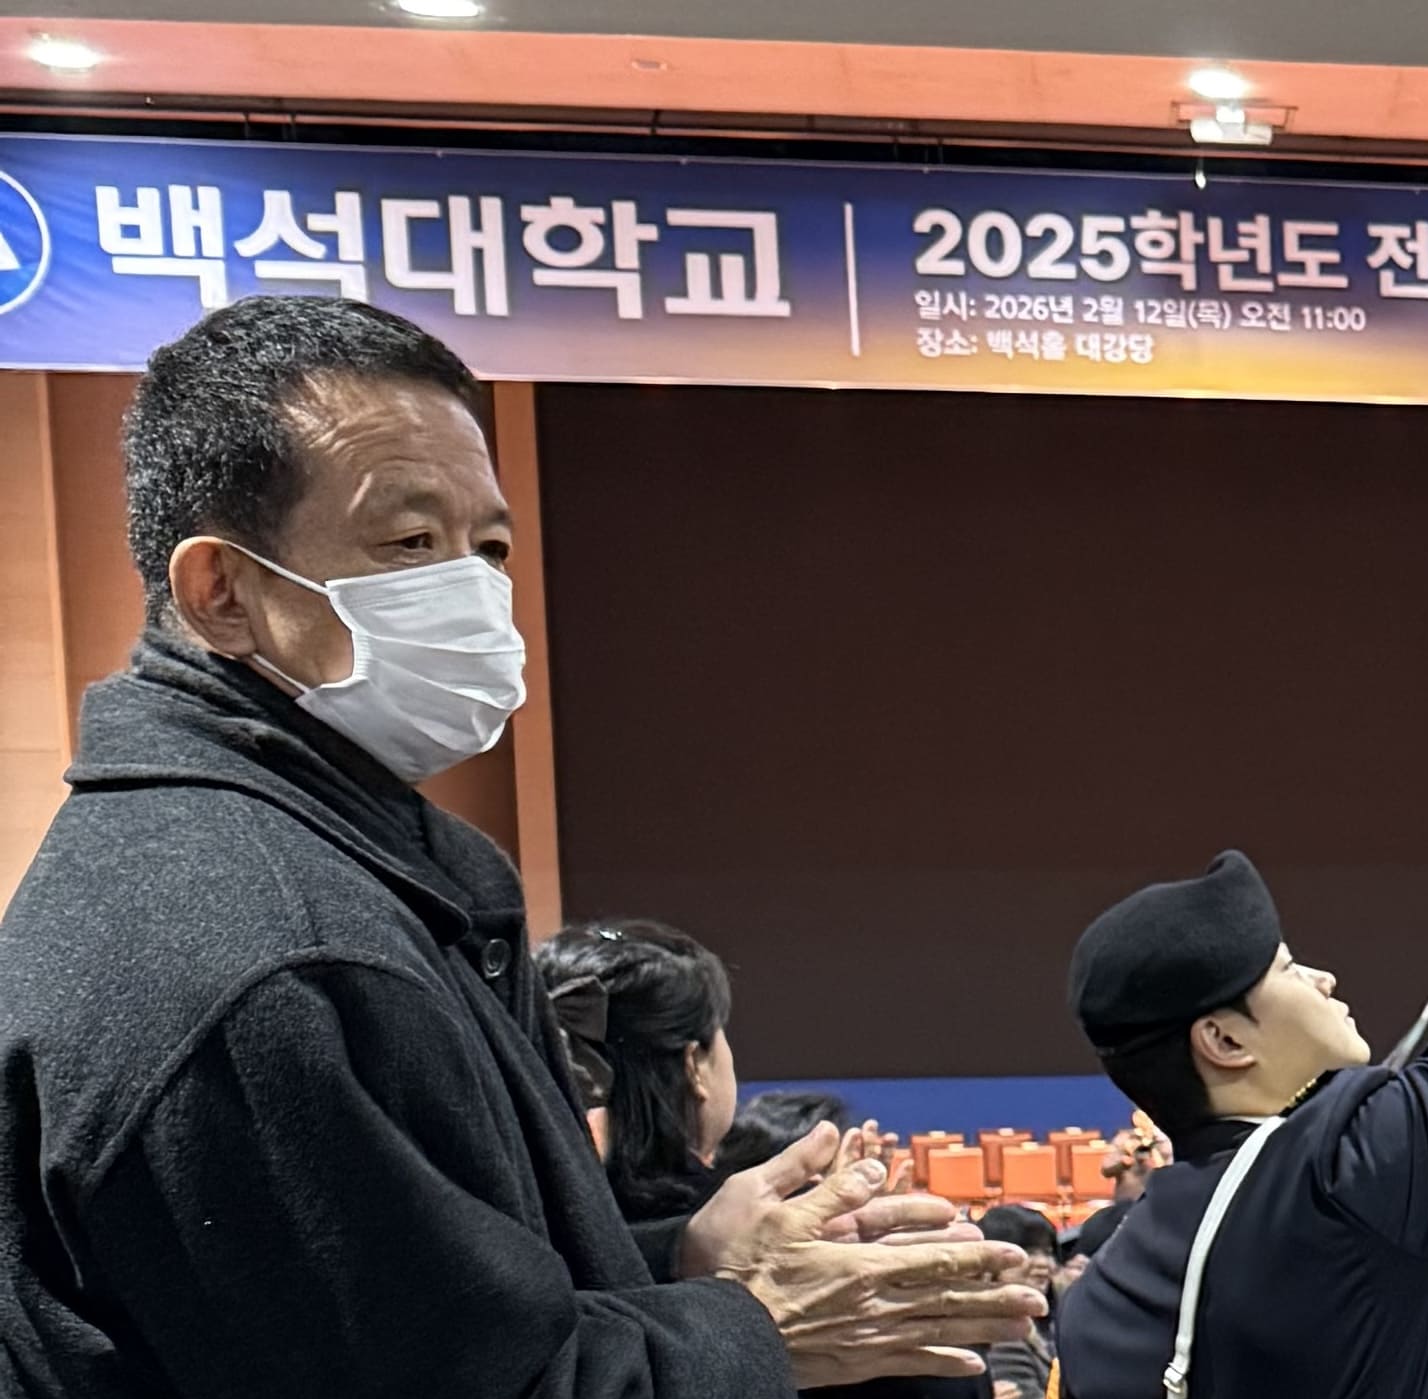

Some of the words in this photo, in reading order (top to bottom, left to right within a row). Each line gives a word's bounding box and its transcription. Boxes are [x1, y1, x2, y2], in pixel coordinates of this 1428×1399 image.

[95, 185, 791, 319] 백석대학교
[912, 208, 1349, 292] 2025학년도
[914, 289, 977, 321] 일시:
[984, 293, 1075, 324] 2026년
[1082, 295, 1124, 326] 2월
[1133, 298, 1232, 329] 12일(목)
[1240, 302, 1292, 331] 오전
[1301, 306, 1367, 331] 11:00
[915, 327, 979, 358] 장소:
[986, 329, 1067, 361] 백석홀
[1074, 332, 1154, 364] 대강당
